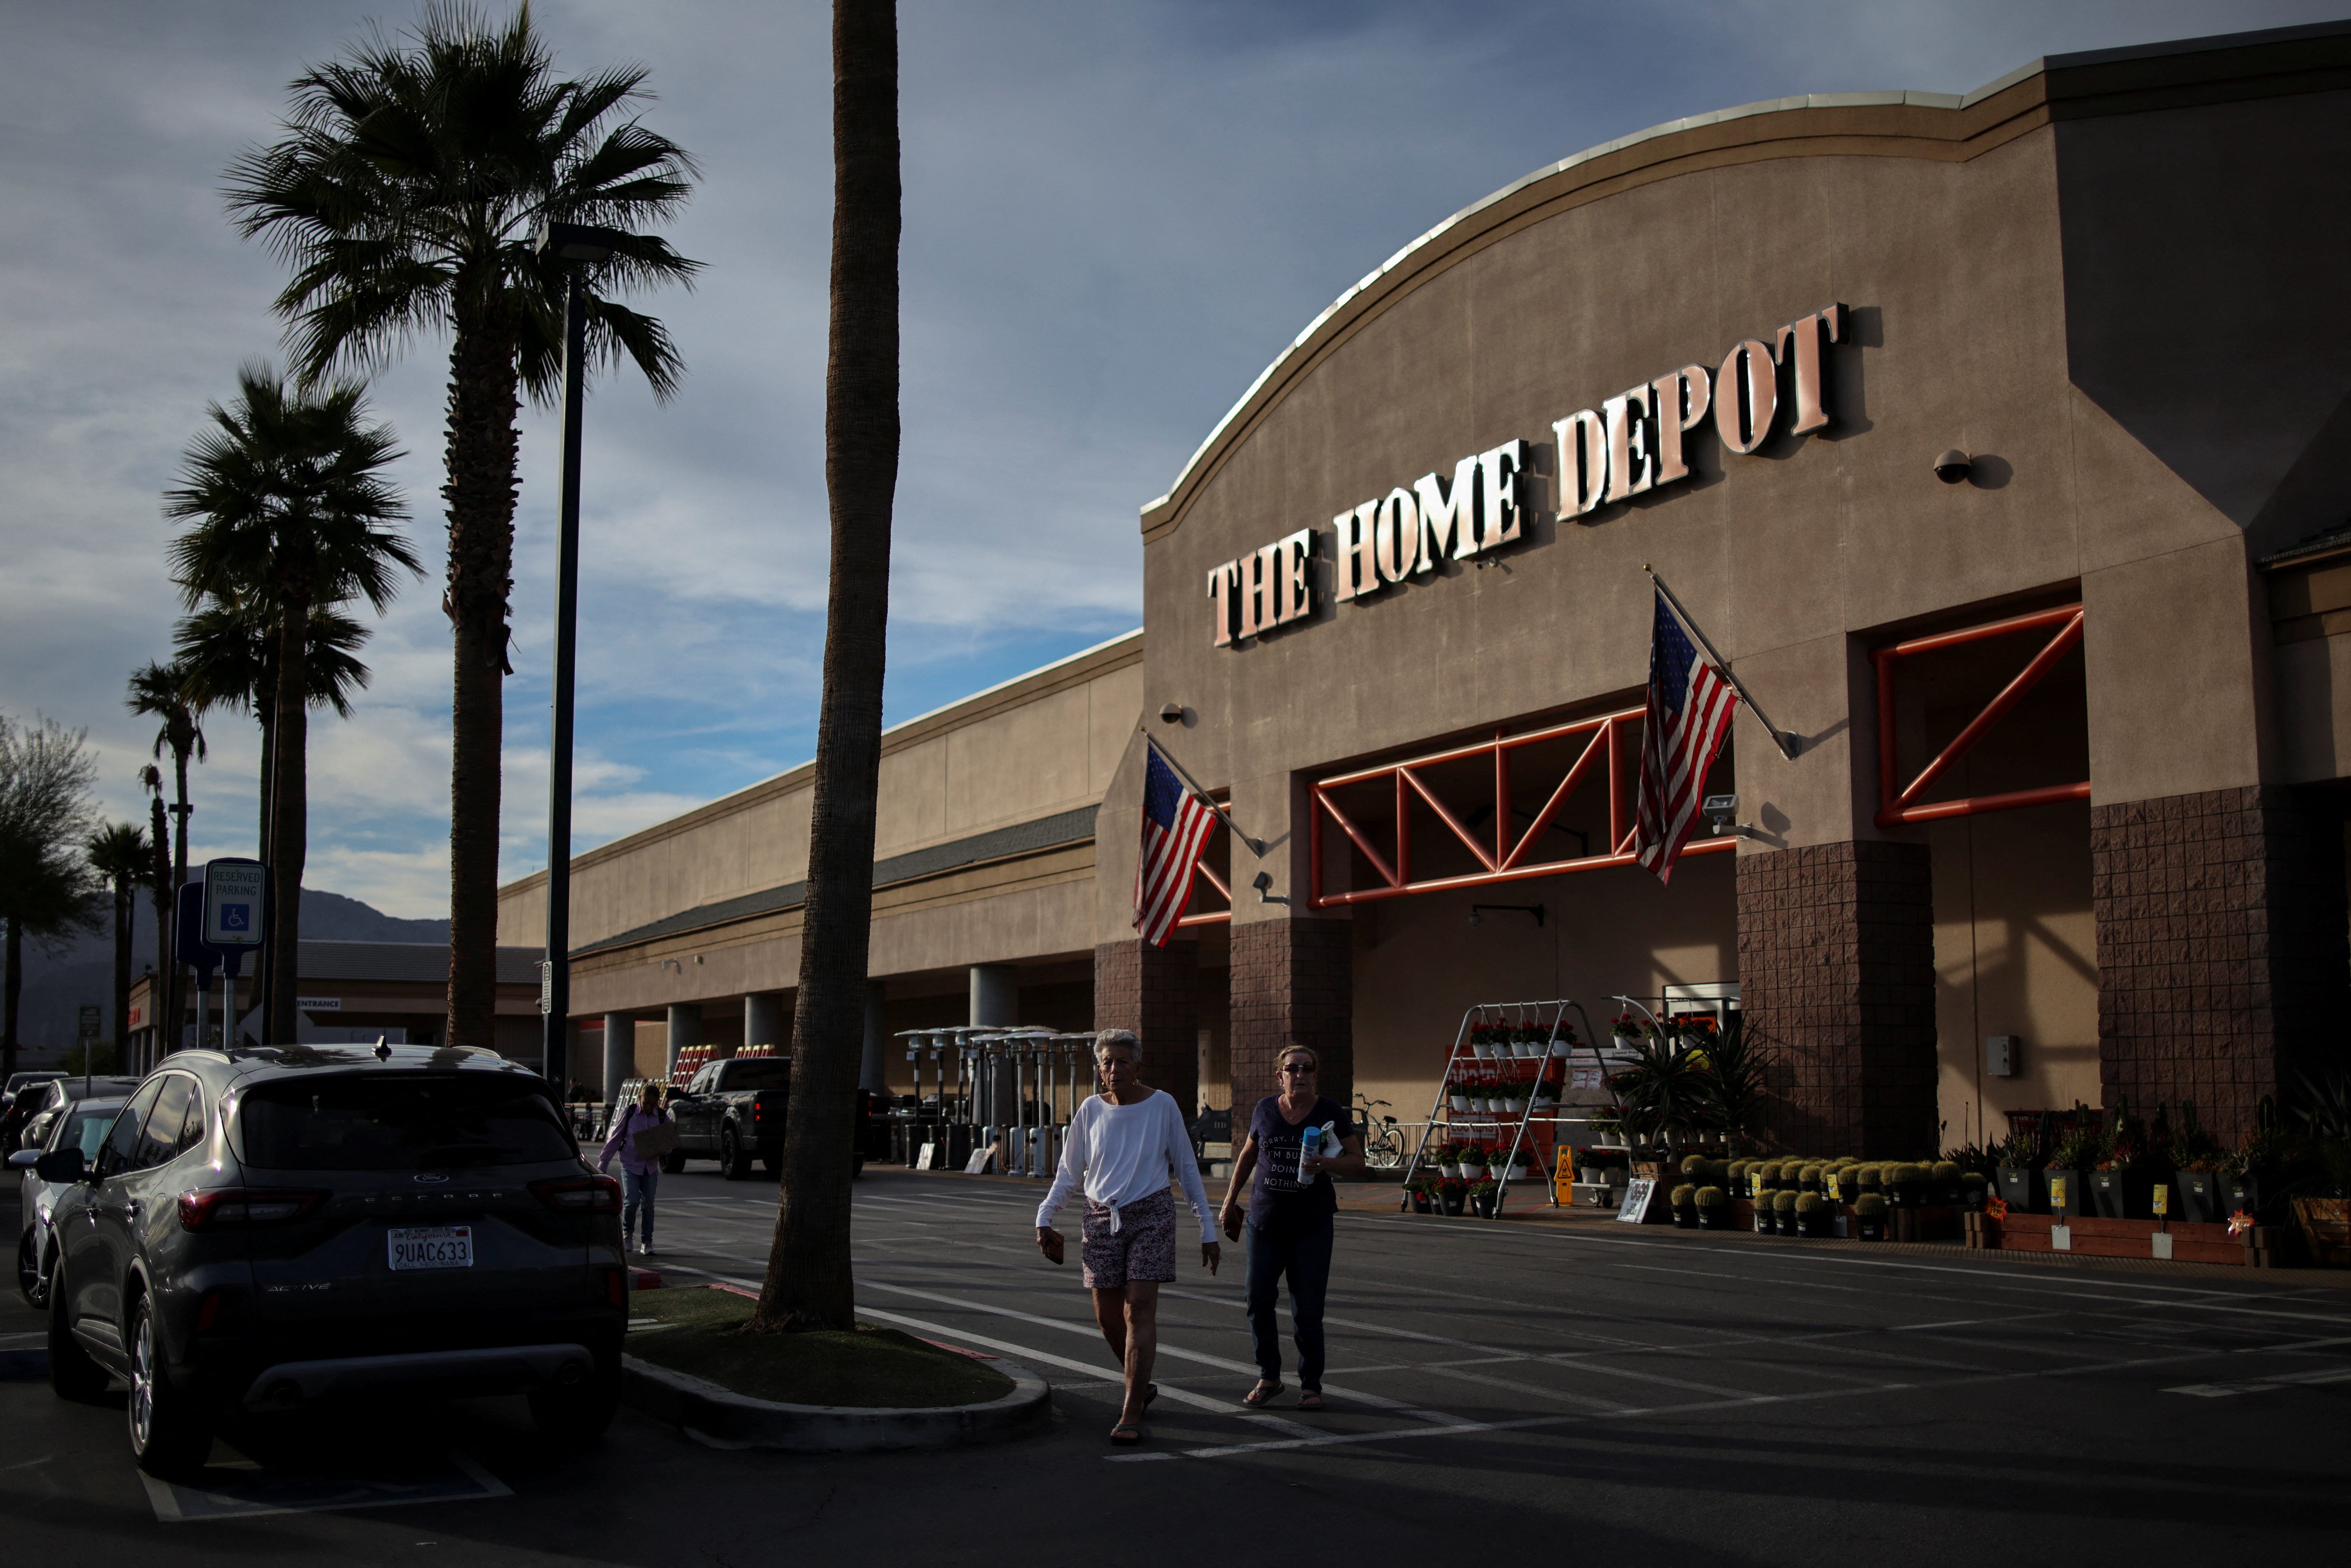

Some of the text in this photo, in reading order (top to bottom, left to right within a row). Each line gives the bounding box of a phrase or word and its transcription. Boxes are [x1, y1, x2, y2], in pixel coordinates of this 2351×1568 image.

[1207, 302, 1842, 647] THE HOME DEPOT
[214, 871, 260, 883] RESERVED
[216, 885, 256, 896] PARKING
[1261, 1136, 1287, 1151] SORRY,
[1264, 1177, 1308, 1188] NOTHING
[407, 1232, 456, 1242] California
[396, 1241, 467, 1262] 9UAC633
